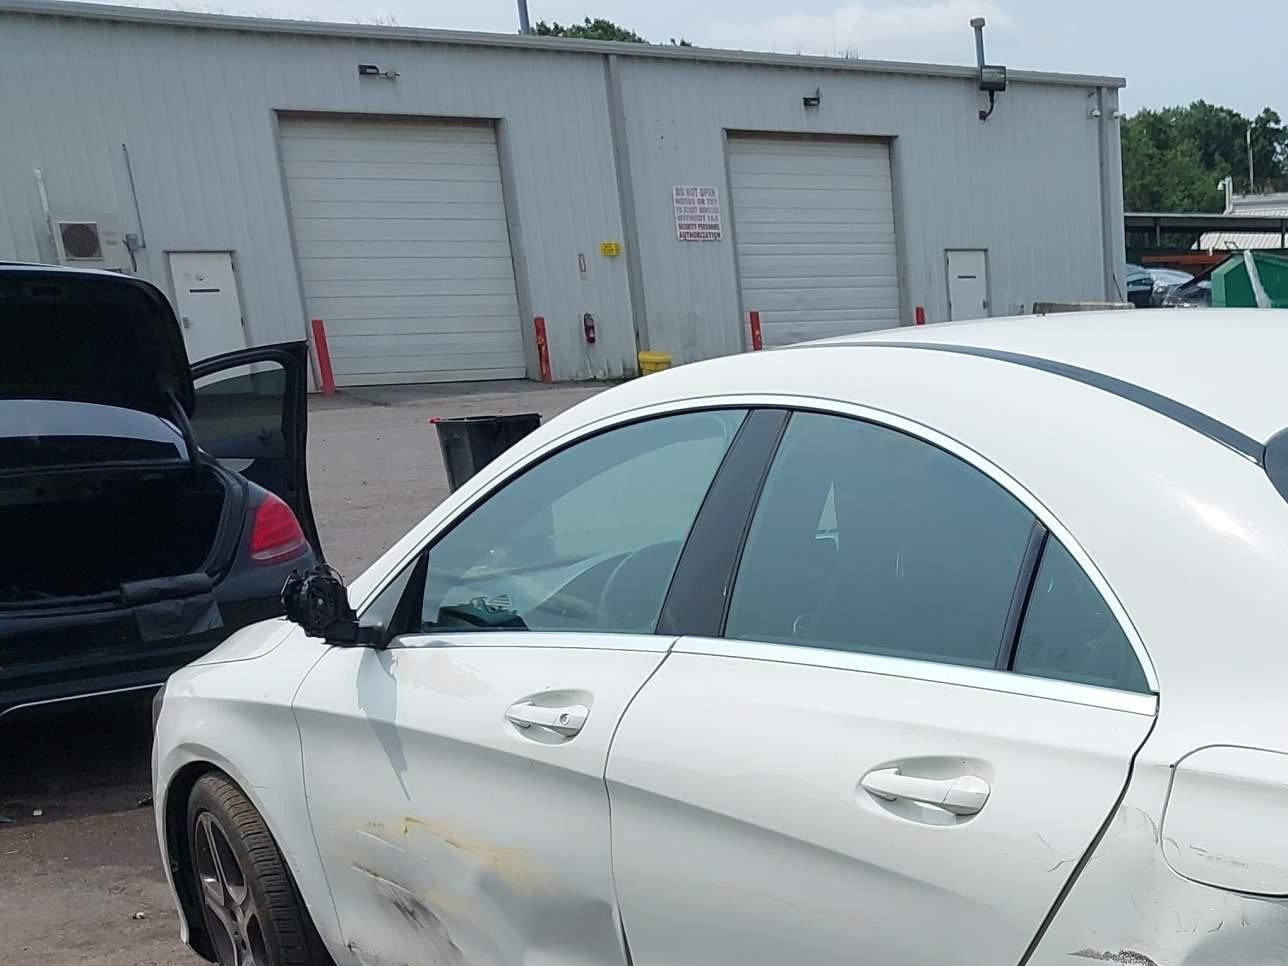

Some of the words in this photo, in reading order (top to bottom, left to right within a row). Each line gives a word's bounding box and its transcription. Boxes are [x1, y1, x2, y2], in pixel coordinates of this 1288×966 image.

[675, 187, 684, 197] DO
[686, 187, 698, 197] NOT
[699, 187, 716, 197] OPEN
